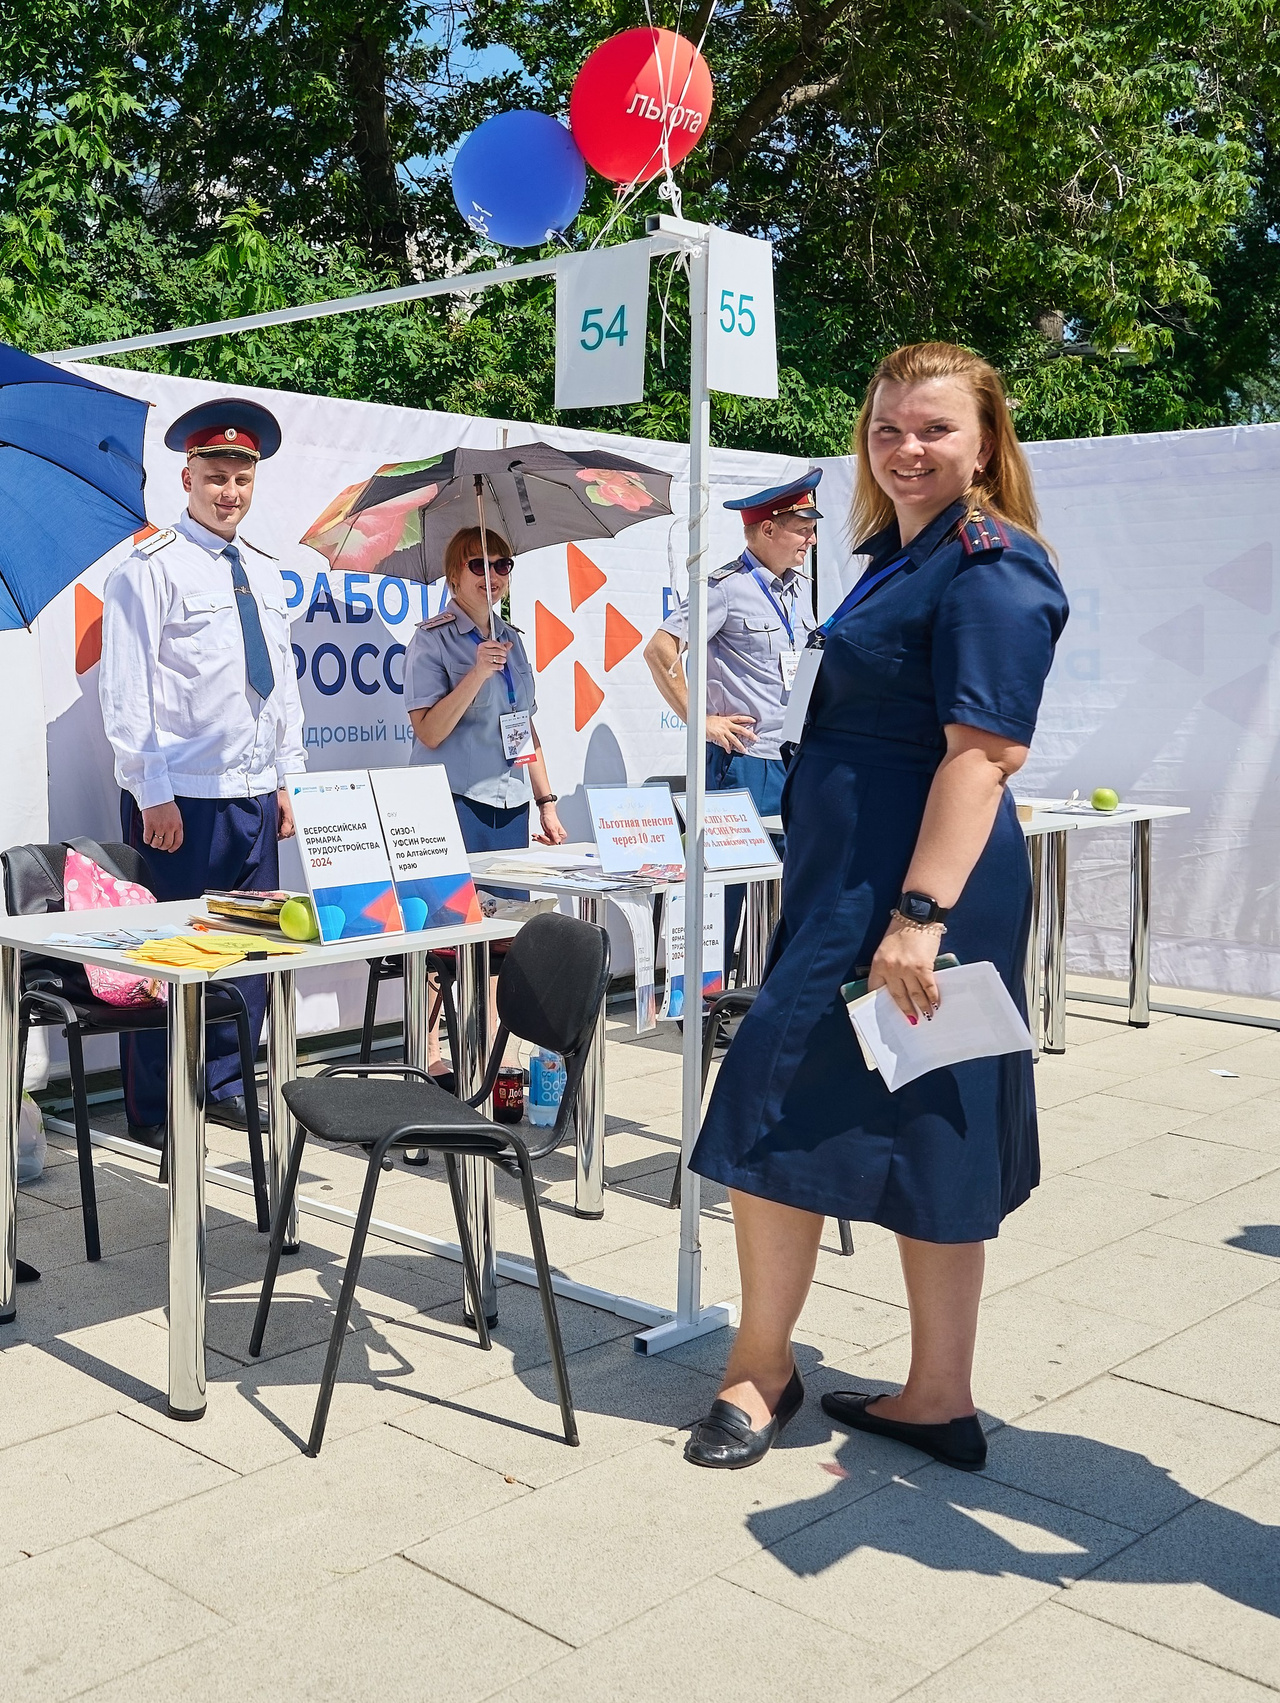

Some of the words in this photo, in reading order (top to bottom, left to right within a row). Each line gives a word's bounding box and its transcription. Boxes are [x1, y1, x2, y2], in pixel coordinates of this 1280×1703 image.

[719, 289, 756, 337] 55
[580, 304, 629, 351] 54
[280, 570, 449, 625] РАБОТ
[302, 719, 387, 749] дровый
[303, 822, 368, 836] ВСЕРОССИЙСКАЯ
[598, 817, 640, 830] Льготная
[641, 817, 674, 827] пенсия
[390, 826, 416, 836] СИЗО-1
[305, 835, 343, 846] ЯРМАРКА
[392, 837, 420, 848] УФСИН
[420, 836, 446, 844] России
[612, 835, 637, 848] через
[638, 832, 649, 844] 10
[650, 834, 666, 843] лет
[307, 841, 381, 856] ТРУДОУСТРОЙСТВА
[406, 847, 449, 858] Алтайскому
[310, 857, 333, 868] 2024
[398, 862, 418, 872] краю
